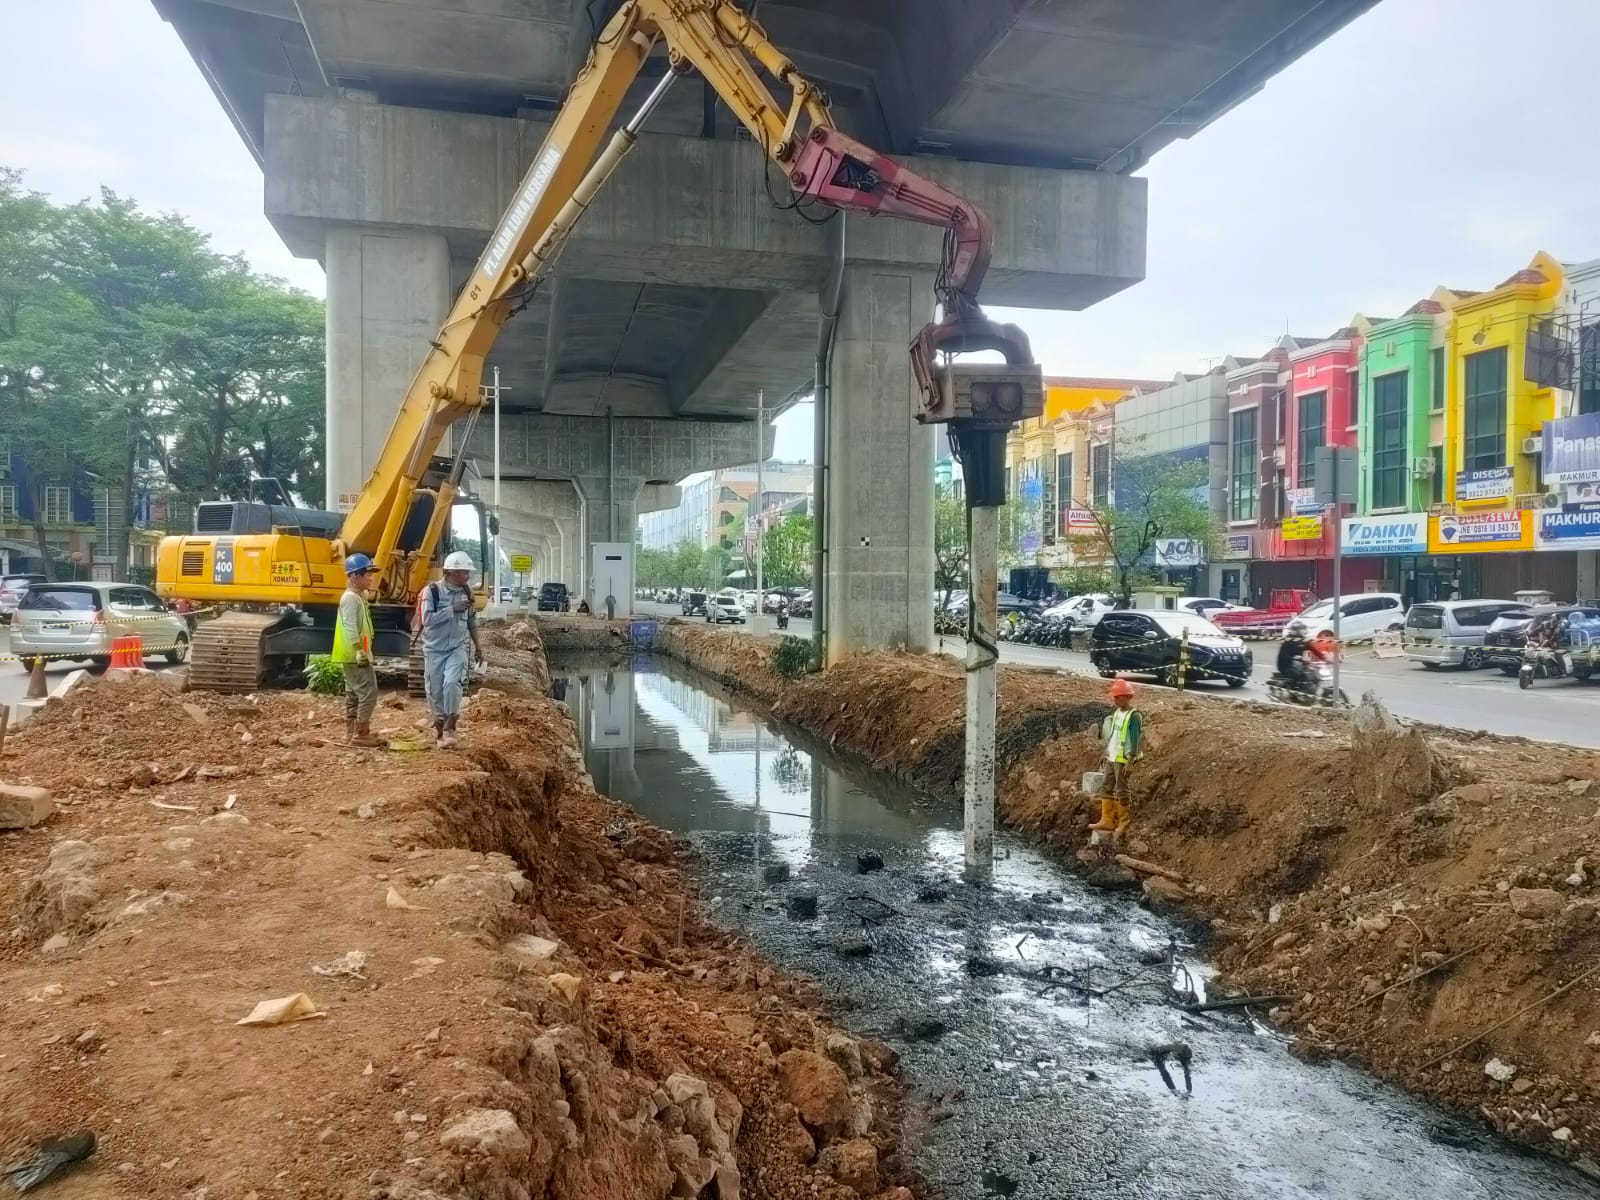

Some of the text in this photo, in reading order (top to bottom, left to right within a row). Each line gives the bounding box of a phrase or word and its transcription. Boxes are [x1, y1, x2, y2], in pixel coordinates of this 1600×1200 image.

[493, 226, 515, 263] ALAM
[523, 148, 561, 204] BERSAMA
[470, 284, 482, 300] 81
[1560, 471, 1598, 481] MAKMUR
[1545, 512, 1600, 527] MAKMUR
[1361, 524, 1418, 538] DAIKIN
[1166, 541, 1194, 554] ACA
[216, 551, 226, 560] PC
[215, 561, 232, 573] 400
[214, 574, 222, 582] LC
[273, 575, 299, 584] KOMATSU
